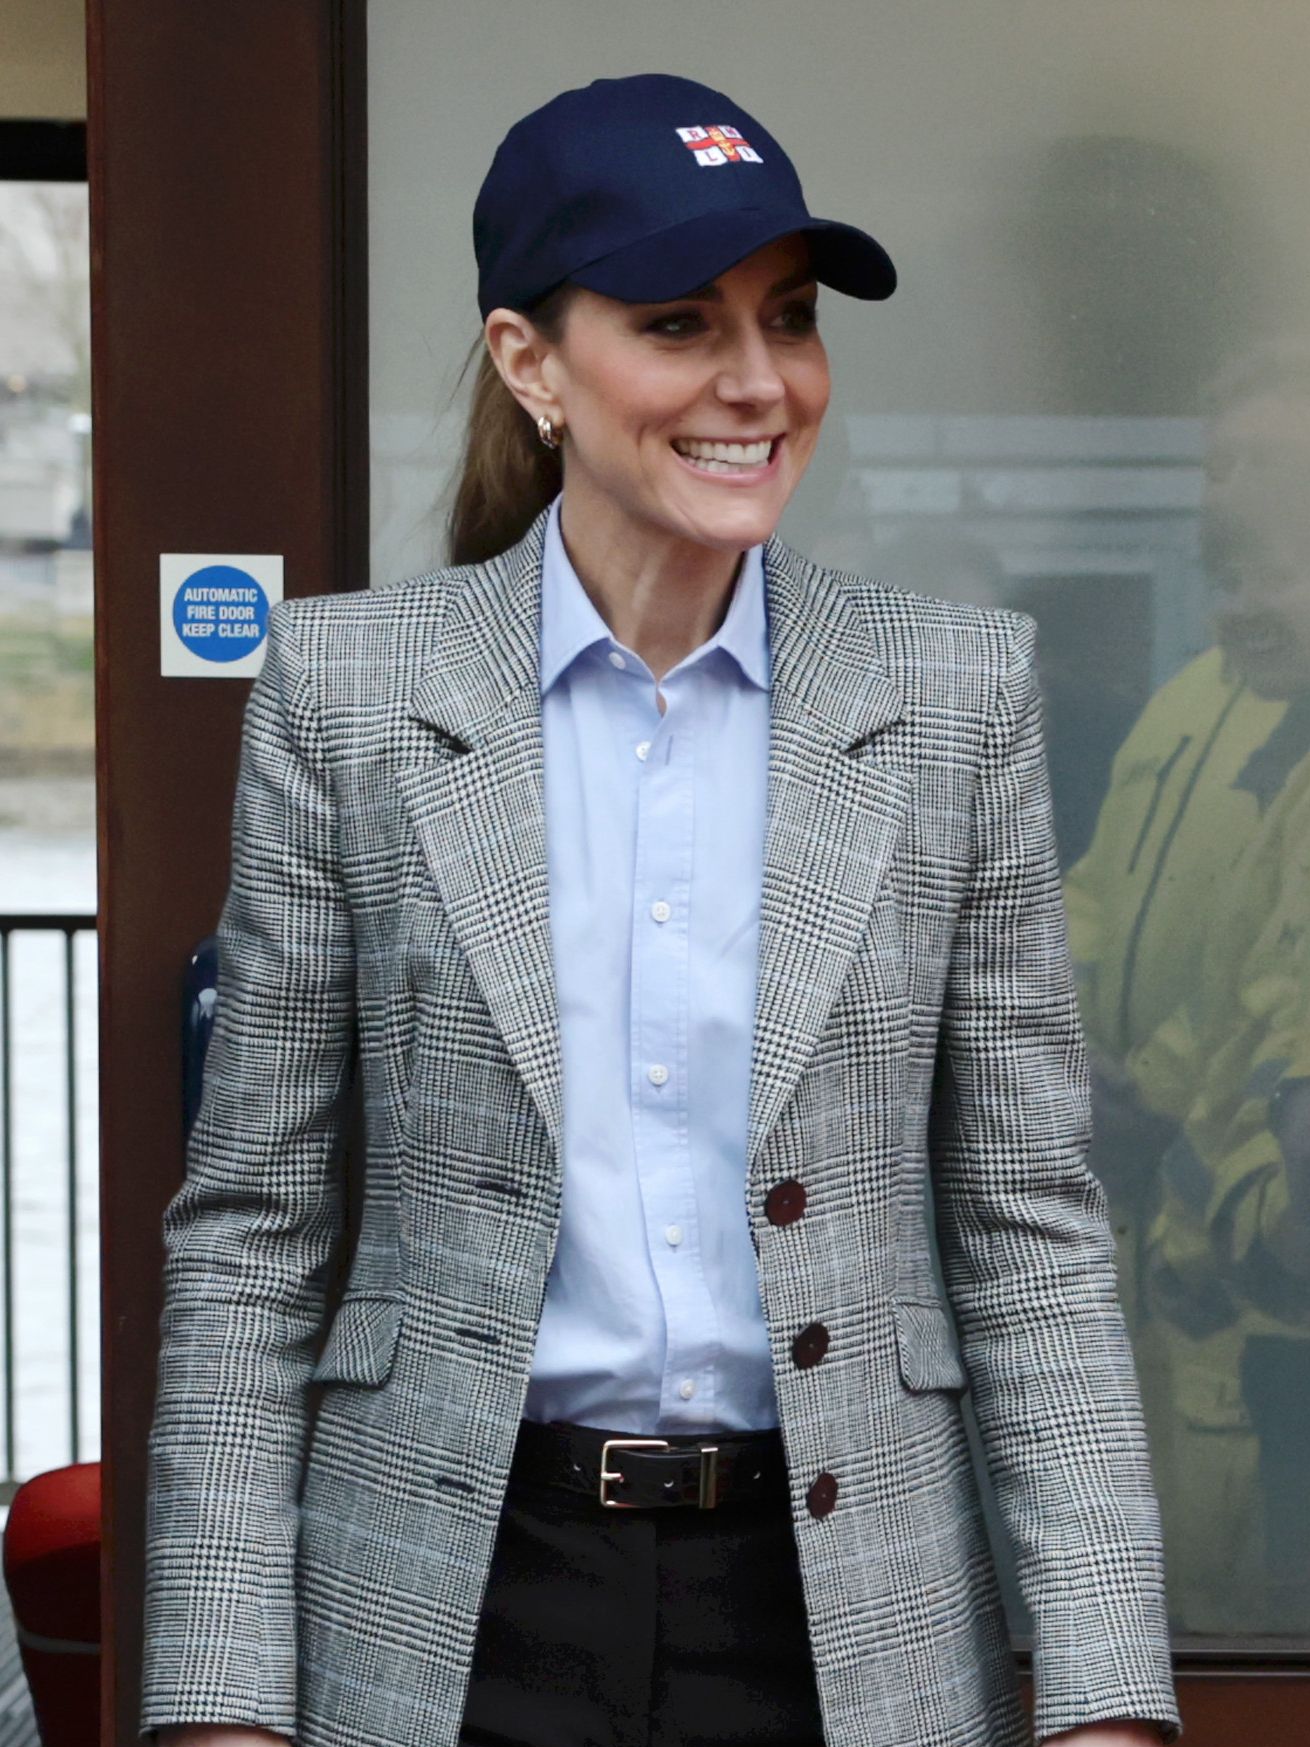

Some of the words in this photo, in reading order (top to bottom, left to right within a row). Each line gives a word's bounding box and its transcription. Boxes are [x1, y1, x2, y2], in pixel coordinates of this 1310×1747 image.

[184, 588, 257, 602] AUTOMATIC
[187, 604, 216, 620] FIRE
[218, 605, 255, 620] DOOR
[182, 623, 215, 637] KEEP
[218, 623, 259, 638] CLEAR
